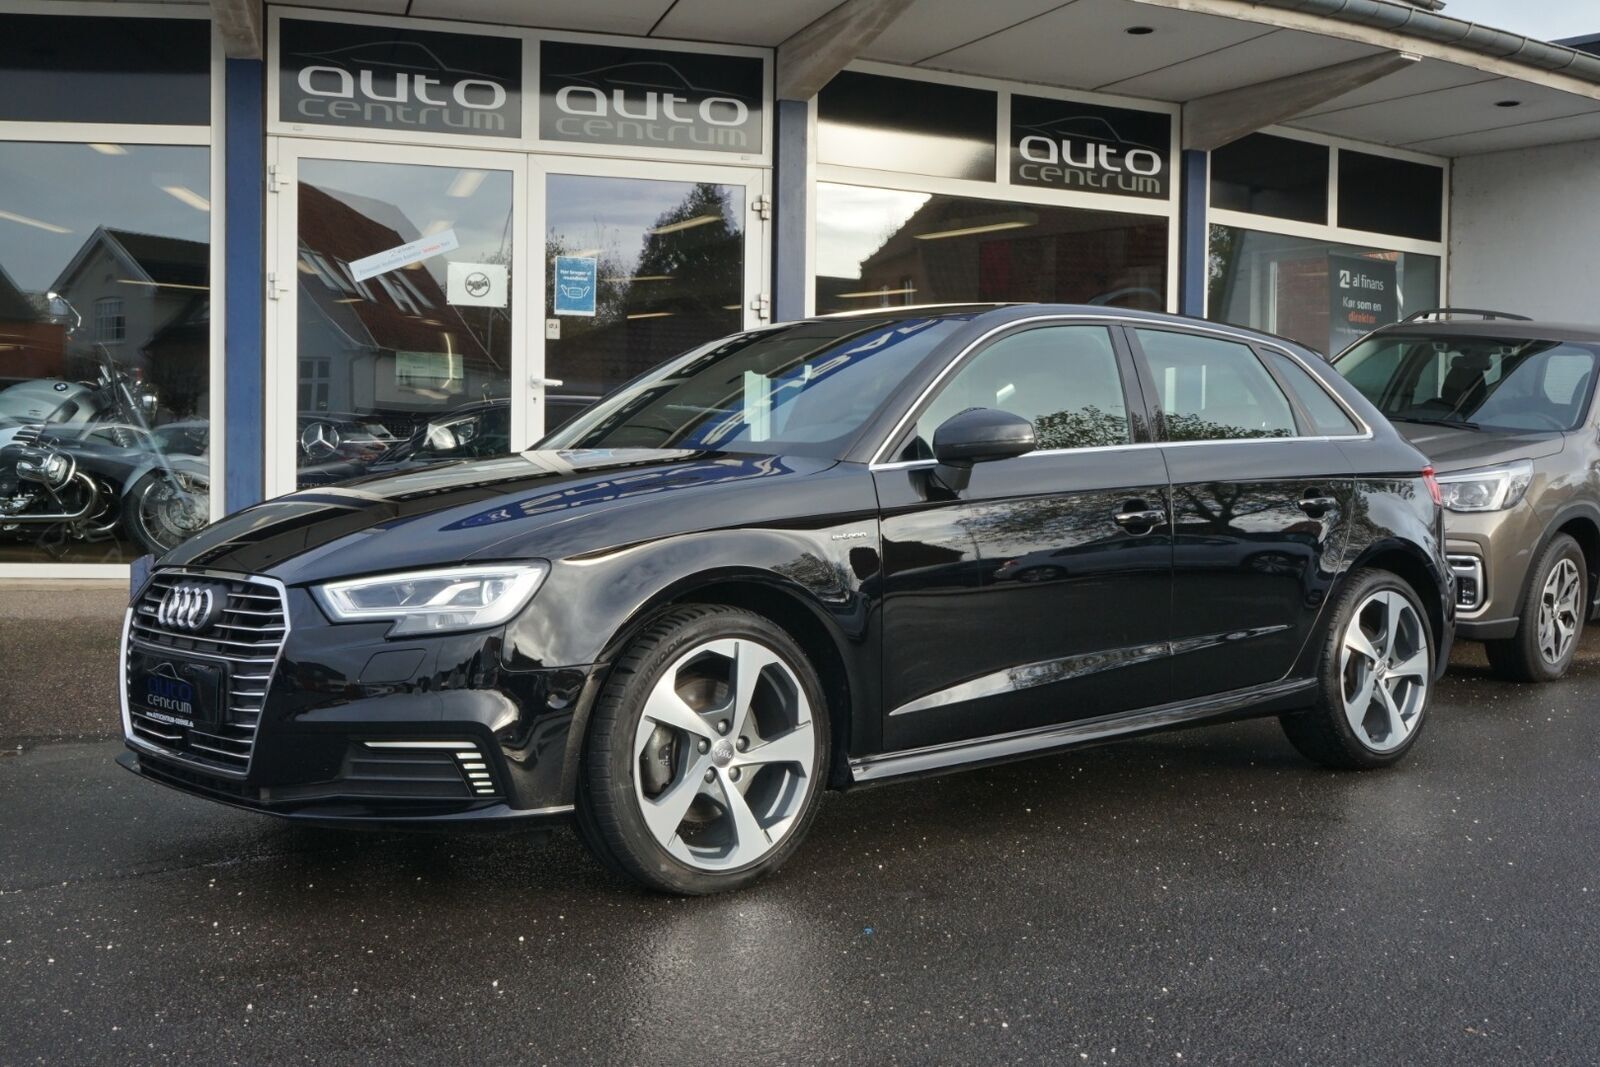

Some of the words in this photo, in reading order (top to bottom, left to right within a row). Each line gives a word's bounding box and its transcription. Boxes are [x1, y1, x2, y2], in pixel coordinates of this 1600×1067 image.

[297, 64, 507, 111] auto
[297, 96, 506, 131] centrum
[555, 85, 750, 128] auto
[555, 115, 748, 147] centrum
[1019, 135, 1162, 176] auto
[1018, 163, 1161, 194] centrum
[1361, 274, 1384, 290] finans
[1356, 300, 1372, 310] som
[1373, 303, 1381, 311] en
[147, 694, 192, 714] centrum
